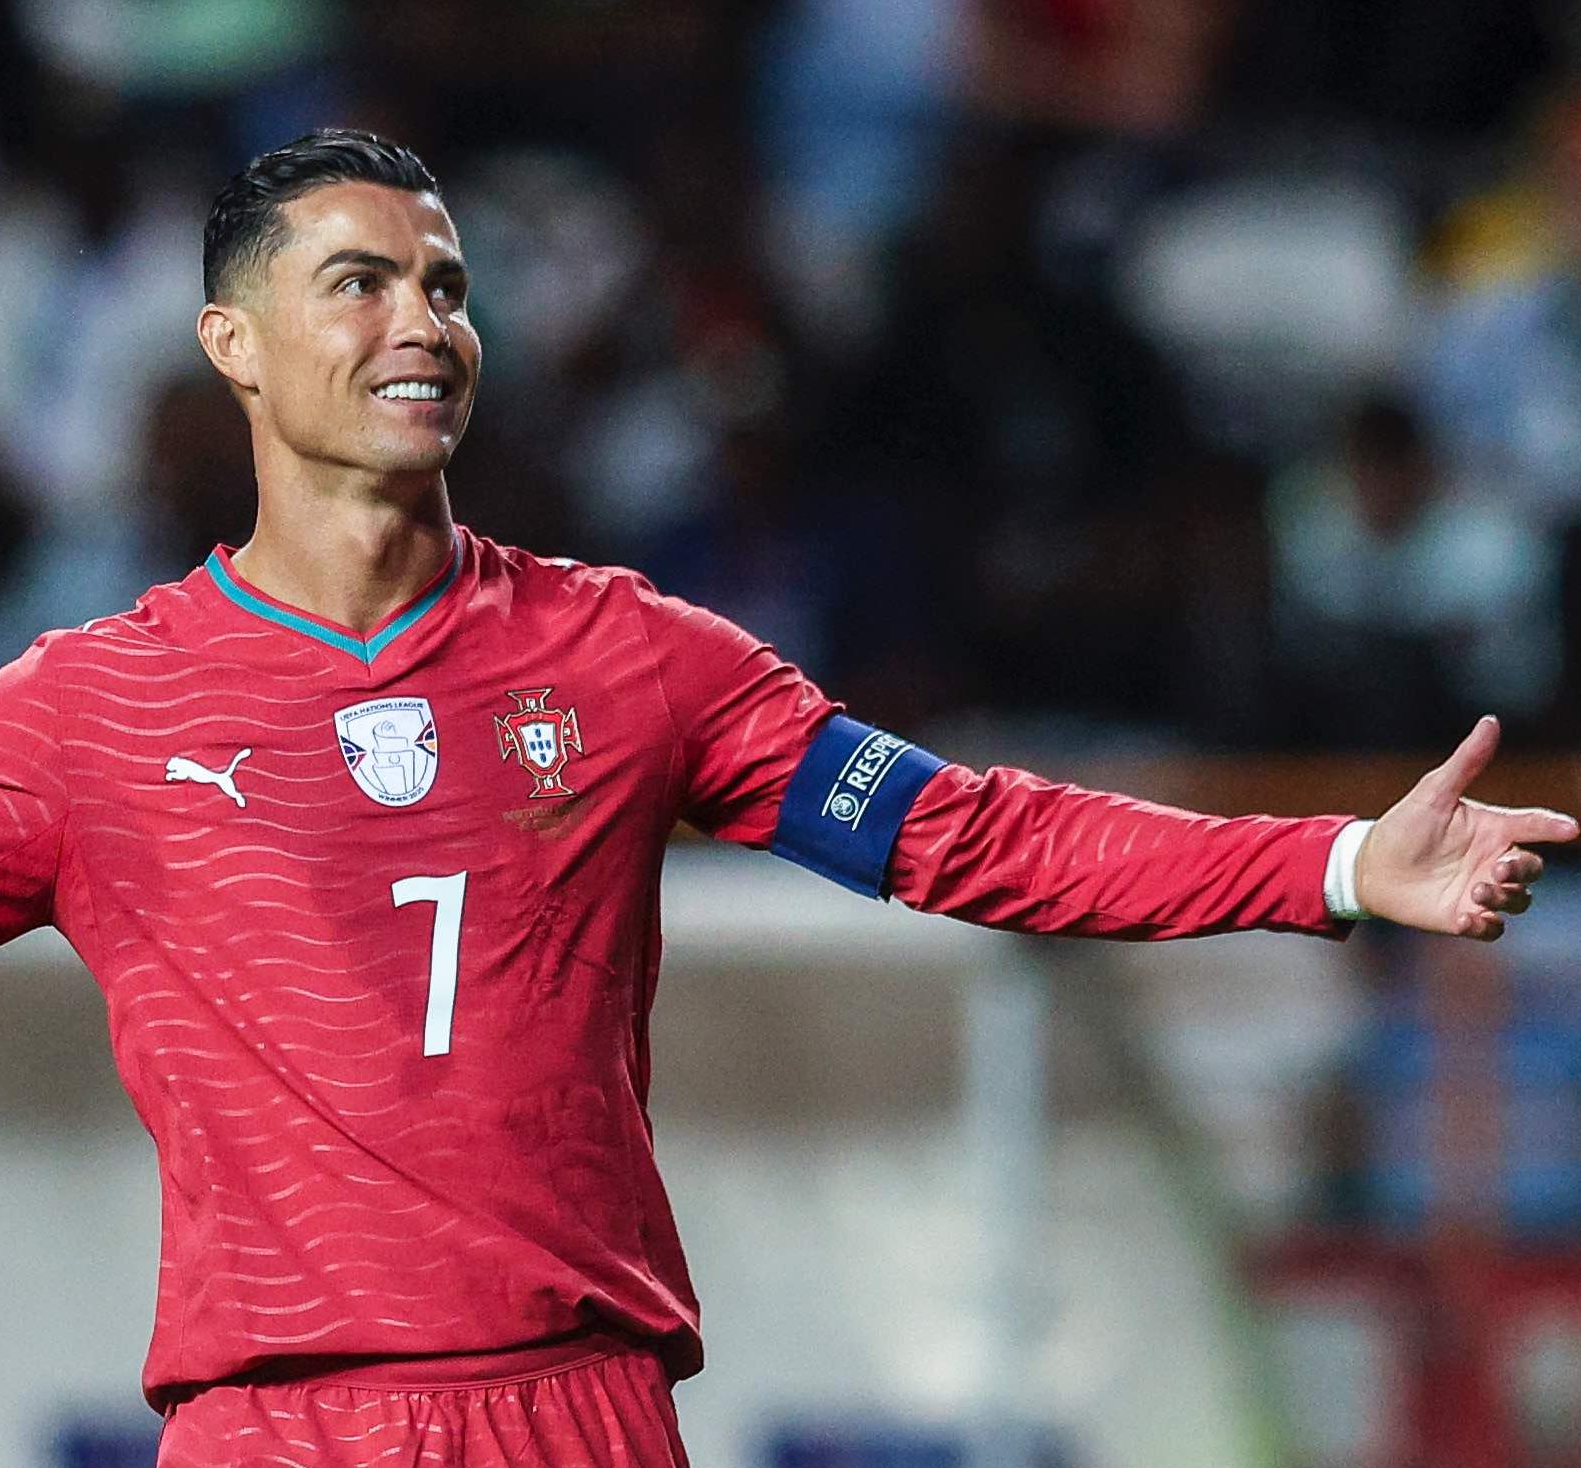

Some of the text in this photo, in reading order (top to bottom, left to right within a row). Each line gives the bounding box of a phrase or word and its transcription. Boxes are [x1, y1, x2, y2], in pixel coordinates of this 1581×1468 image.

[360, 702, 393, 714] NATIONS
[394, 701, 424, 709] LEAGUE
[391, 870, 467, 1057] 7
